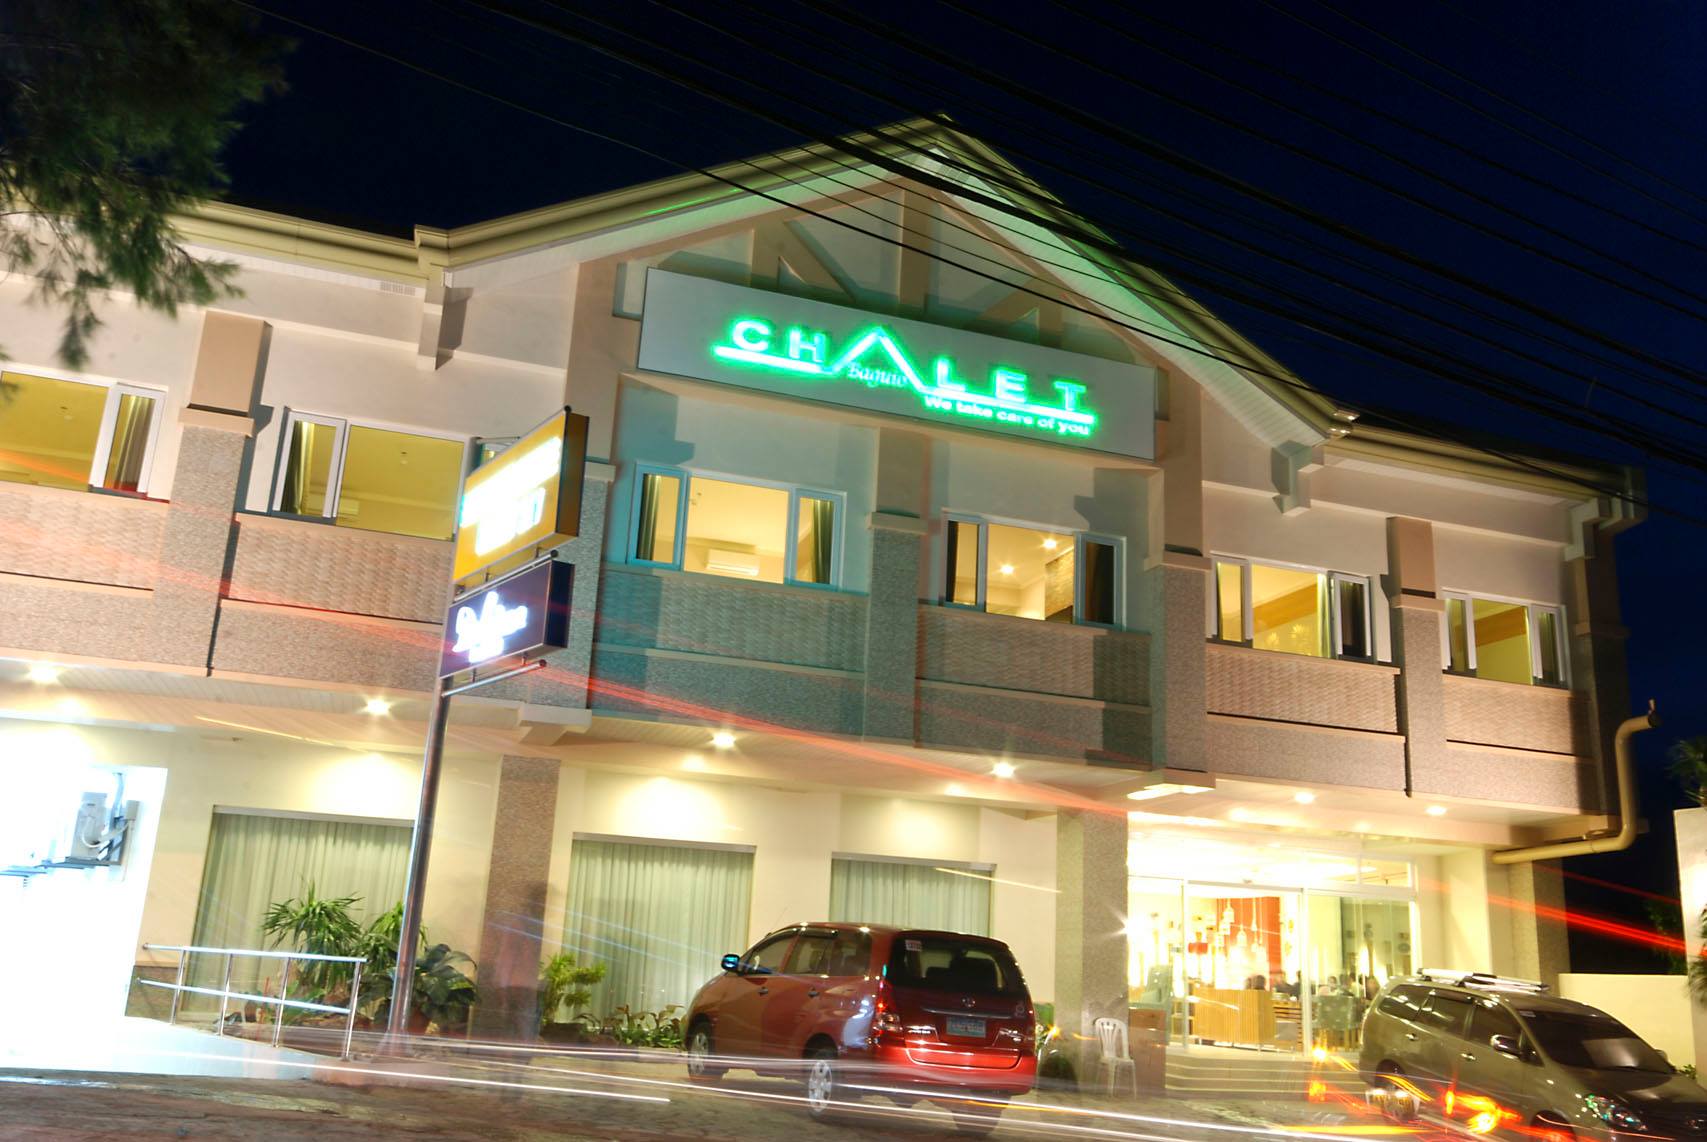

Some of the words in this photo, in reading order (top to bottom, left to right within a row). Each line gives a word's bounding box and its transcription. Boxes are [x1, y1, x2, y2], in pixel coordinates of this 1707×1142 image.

[729, 319, 1089, 413] CHALET
[924, 395, 952, 411] We
[957, 401, 993, 418] take
[997, 409, 1033, 425] care
[1038, 416, 1054, 429] of
[1057, 421, 1089, 435] you
